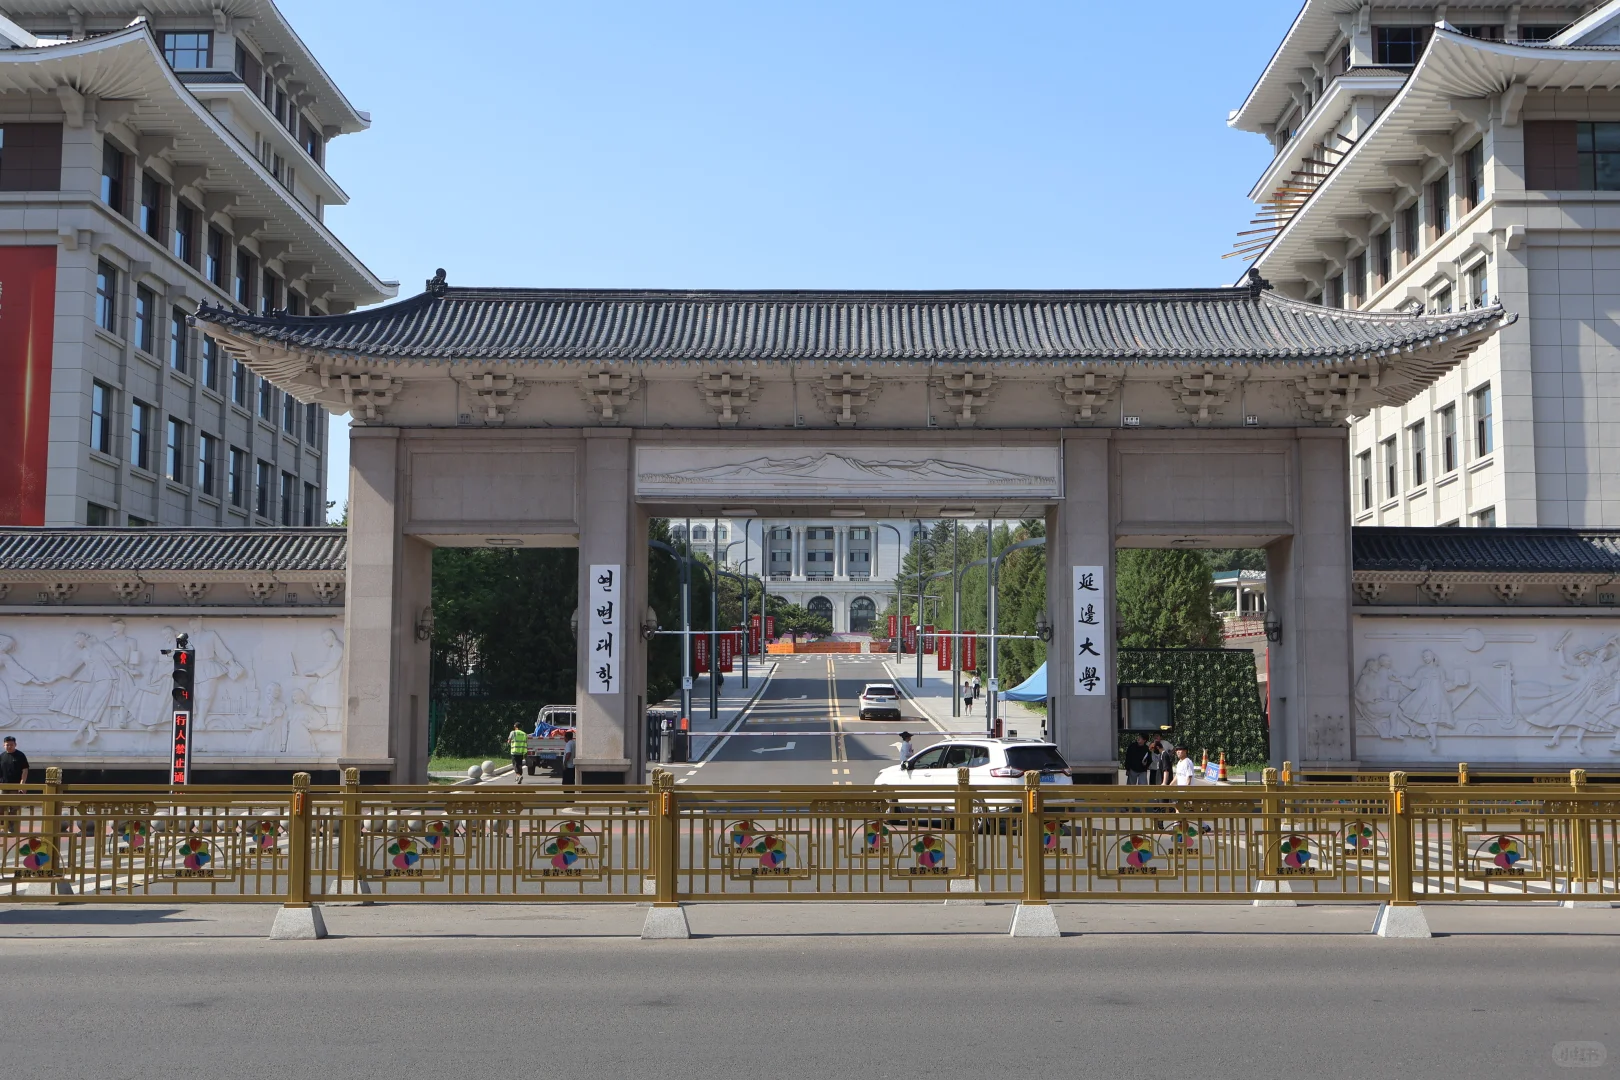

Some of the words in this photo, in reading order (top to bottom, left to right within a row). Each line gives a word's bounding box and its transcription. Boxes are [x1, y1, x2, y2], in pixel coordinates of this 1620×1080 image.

[596, 569, 613, 692] 연변대학
[1077, 573, 1101, 692] 延邊大學
[174, 715, 187, 794] 行人禁止通
